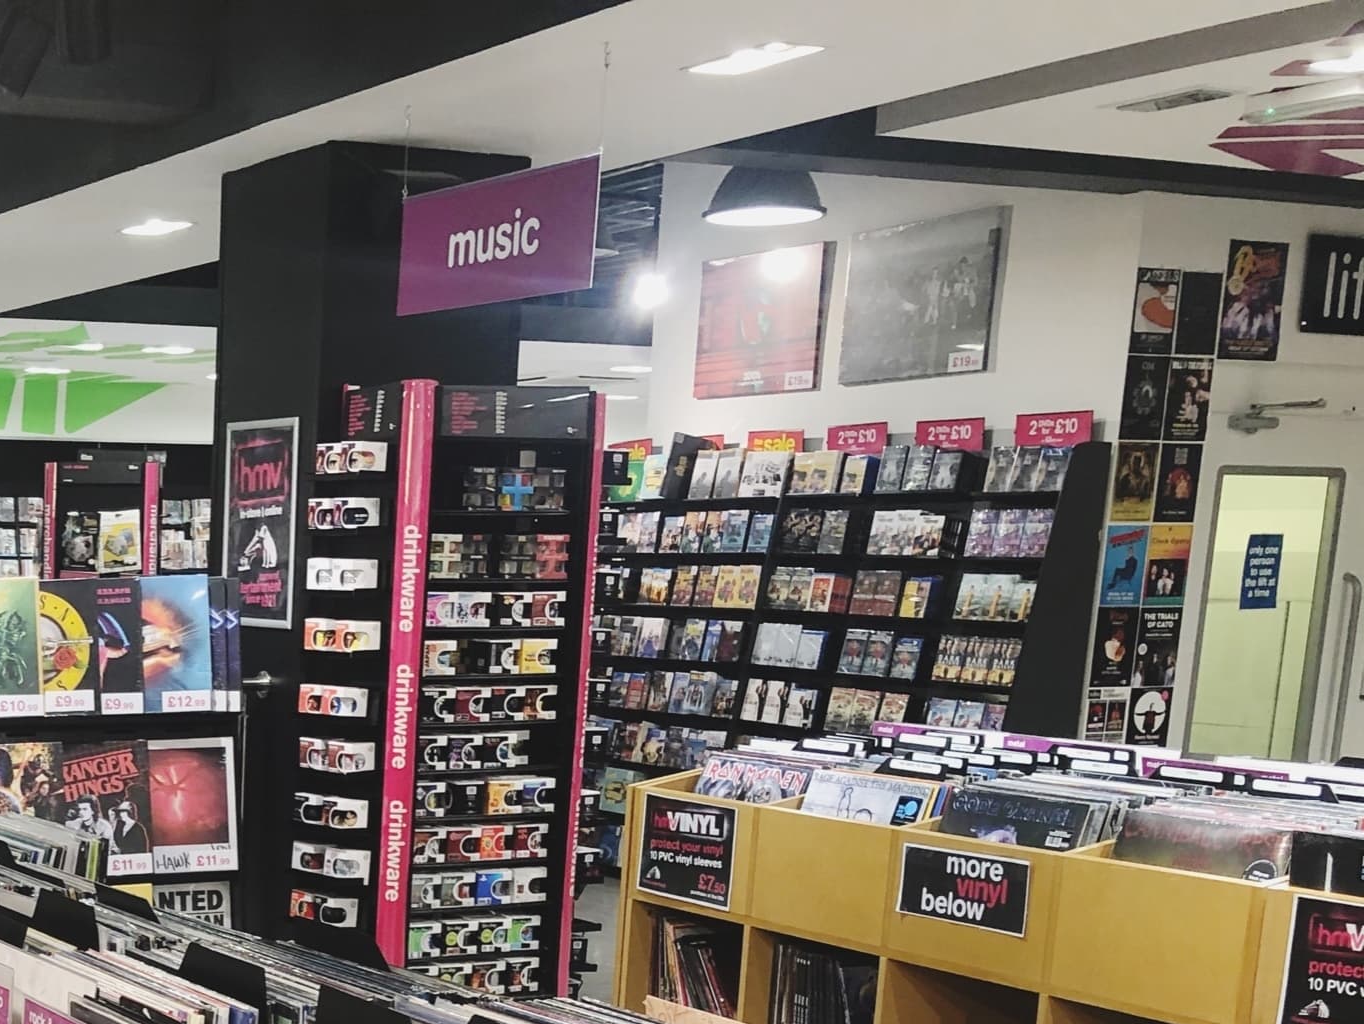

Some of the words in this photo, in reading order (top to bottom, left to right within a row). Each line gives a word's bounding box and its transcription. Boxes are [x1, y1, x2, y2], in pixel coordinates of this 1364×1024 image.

[447, 207, 541, 268] music
[837, 432, 845, 445] 2
[858, 429, 877, 444] £10
[927, 427, 936, 441] 2
[952, 425, 972, 440] £10
[1029, 422, 1037, 435] 2
[1054, 418, 1078, 434] £10
[764, 434, 796, 452] sale
[239, 456, 283, 494] hmv
[1265, 546, 1279, 555] one
[399, 524, 423, 634] drinkware
[1254, 587, 1270, 598] time
[1144, 612, 1156, 620] THE
[1156, 612, 1180, 620] TRIALS
[391, 664, 415, 769] drinkware
[63, 775, 125, 803] HINGS
[746, 762, 808, 794] MAIDEN
[667, 811, 721, 836] VINYL
[384, 799, 408, 902] drinkware
[650, 838, 680, 850] protect
[681, 842, 701, 853] your
[703, 844, 723, 857] vinyl
[650, 850, 657, 860] 10
[658, 851, 674, 863] PVC
[675, 853, 692, 867] vinyl
[693, 857, 723, 869] sleeves
[946, 855, 1004, 882] more
[158, 889, 224, 911] NTED
[920, 886, 985, 921] below
[956, 877, 1009, 909] vinyl
[1307, 976, 1324, 991] 10
[1326, 978, 1358, 996] PVC
